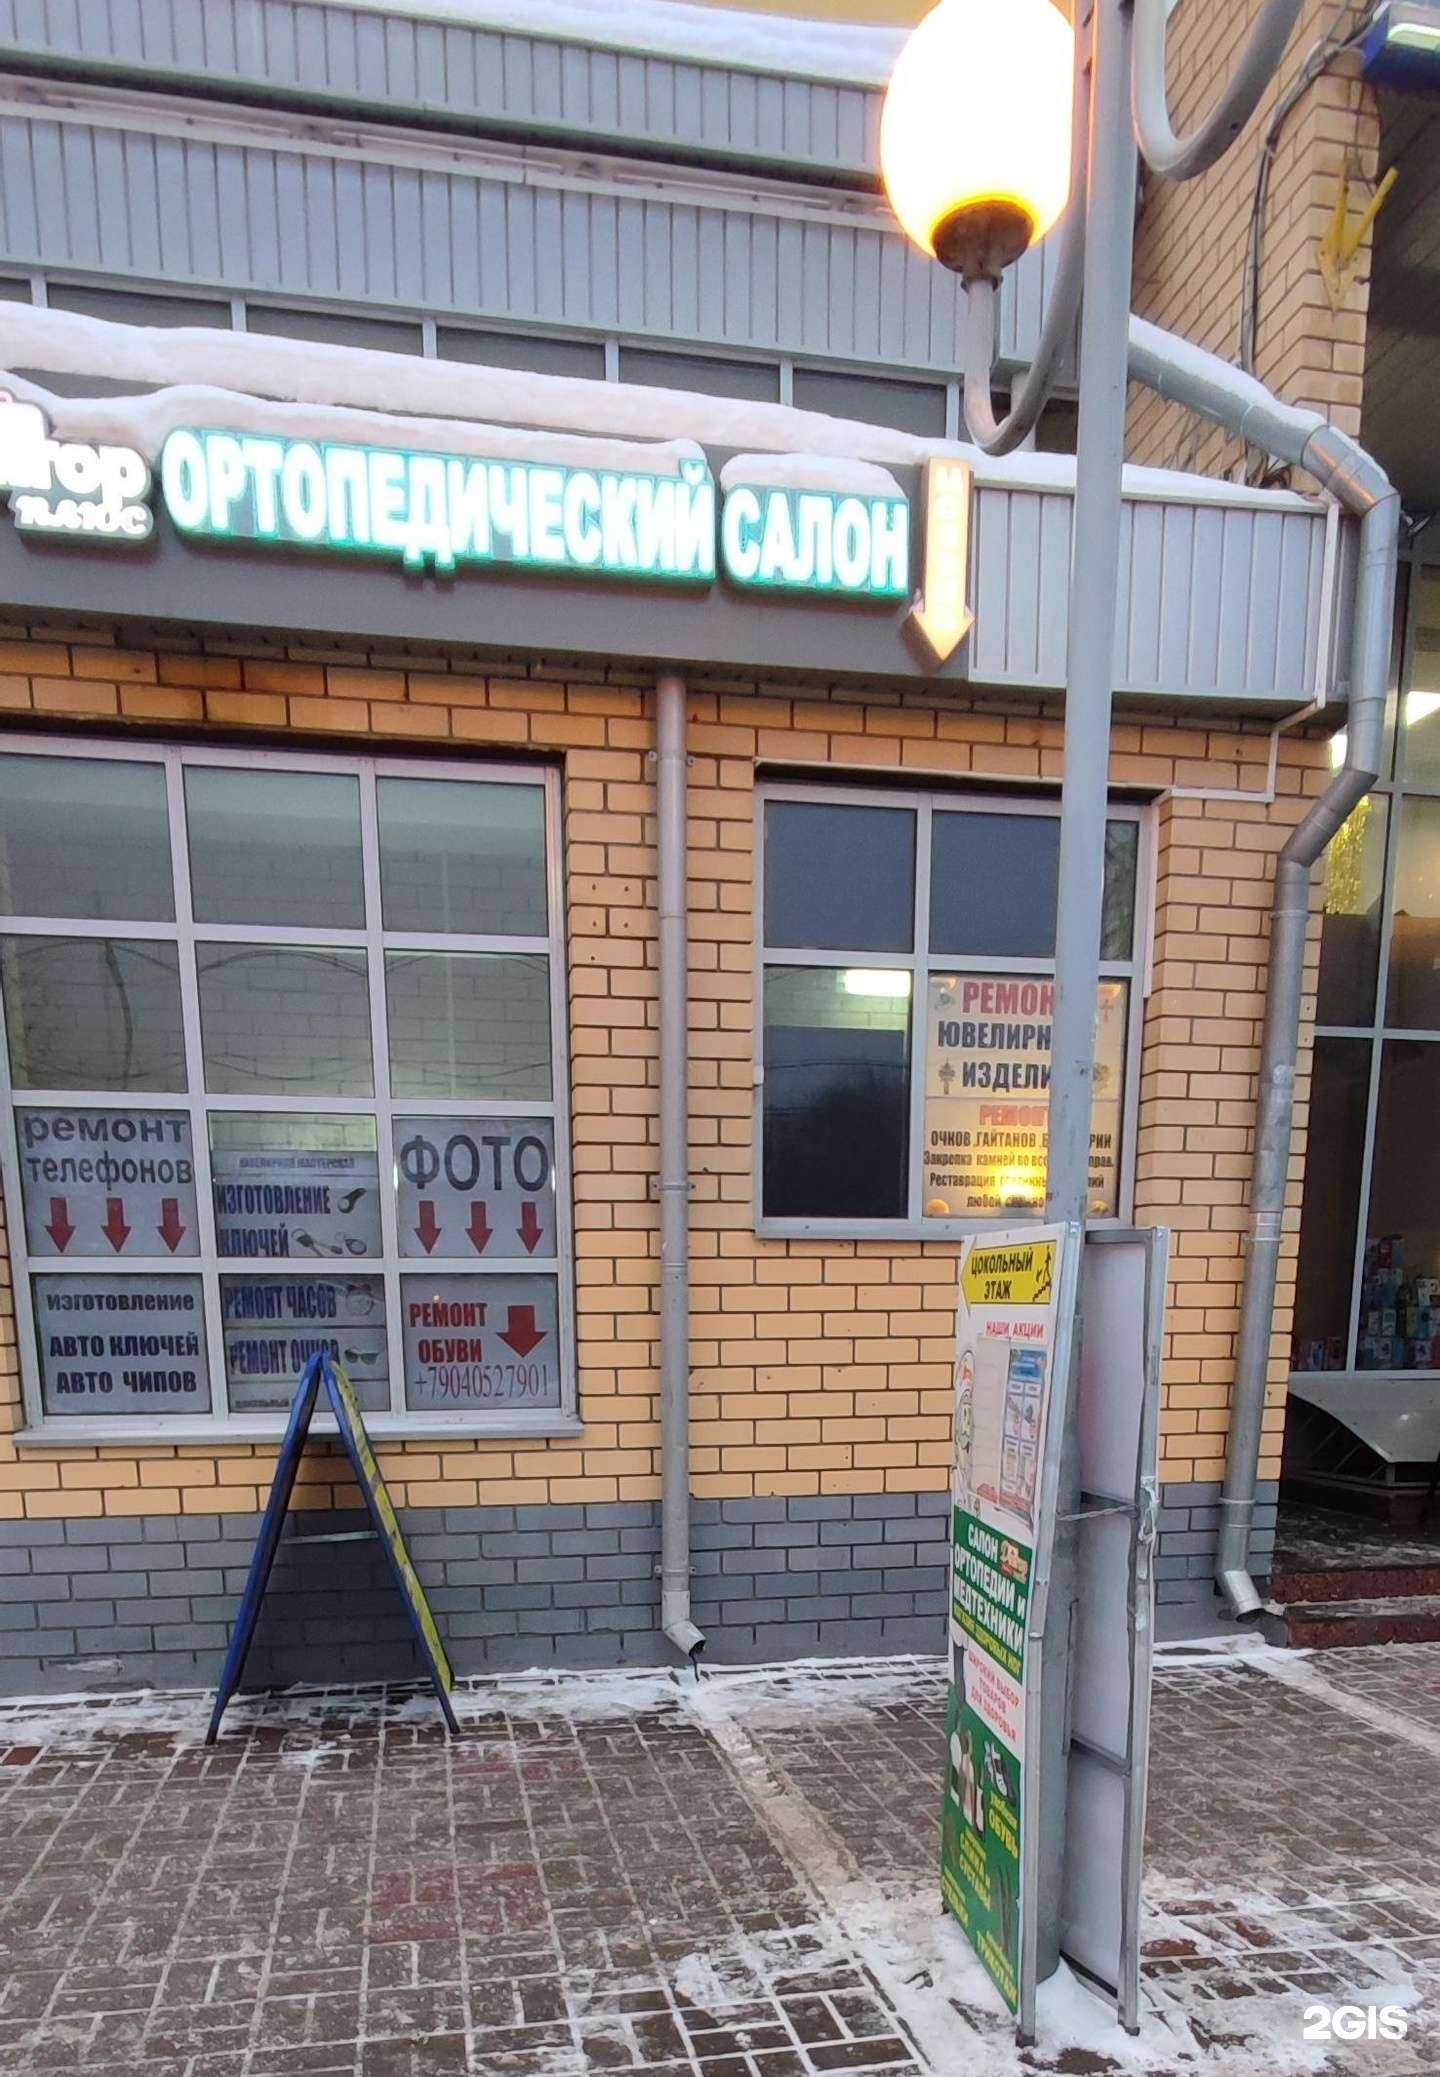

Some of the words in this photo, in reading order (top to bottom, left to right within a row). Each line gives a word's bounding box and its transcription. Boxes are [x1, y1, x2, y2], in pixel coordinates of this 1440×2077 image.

[161, 427, 715, 578] ОРТОПЕДИЧЕСКИЙ
[721, 484, 909, 597] САЛОН
[962, 981, 1054, 1015] РЕМОН
[938, 1020, 1051, 1051] ЮВЕЛИРН
[962, 1062, 1051, 1093] ИЗДЕЛИ
[24, 1117, 187, 1148] ремонт
[931, 1130, 971, 1147] ОЧКОВ
[26, 1150, 192, 1191] телефонов
[400, 1134, 549, 1192] ФОТО
[216, 1184, 331, 1215] ИЗГОТОВЛЕНИЕ
[971, 1247, 1033, 1278] ЦОКОЛЬНЫЙ
[226, 1285, 283, 1319] РЕМОНТ
[286, 1284, 337, 1319] ЧАСОВ
[984, 1280, 1012, 1300] ЭТАЖ
[409, 1302, 488, 1328] РЕМОНТ
[49, 1335, 104, 1357] АВТО
[109, 1331, 199, 1357] КЛЮЧЕЙ
[229, 1339, 287, 1374] РЕМОНТ
[418, 1338, 482, 1364] ОБУВИ
[56, 1371, 113, 1394] АВТО
[123, 1370, 197, 1393] ЧИПОВ
[414, 1364, 548, 1399] +79040527901
[968, 1523, 998, 1563] САЛОН
[954, 1543, 1016, 1611] ОРТОПЕДИИ
[954, 1574, 1023, 1658] МЕДТЕХНИКИ
